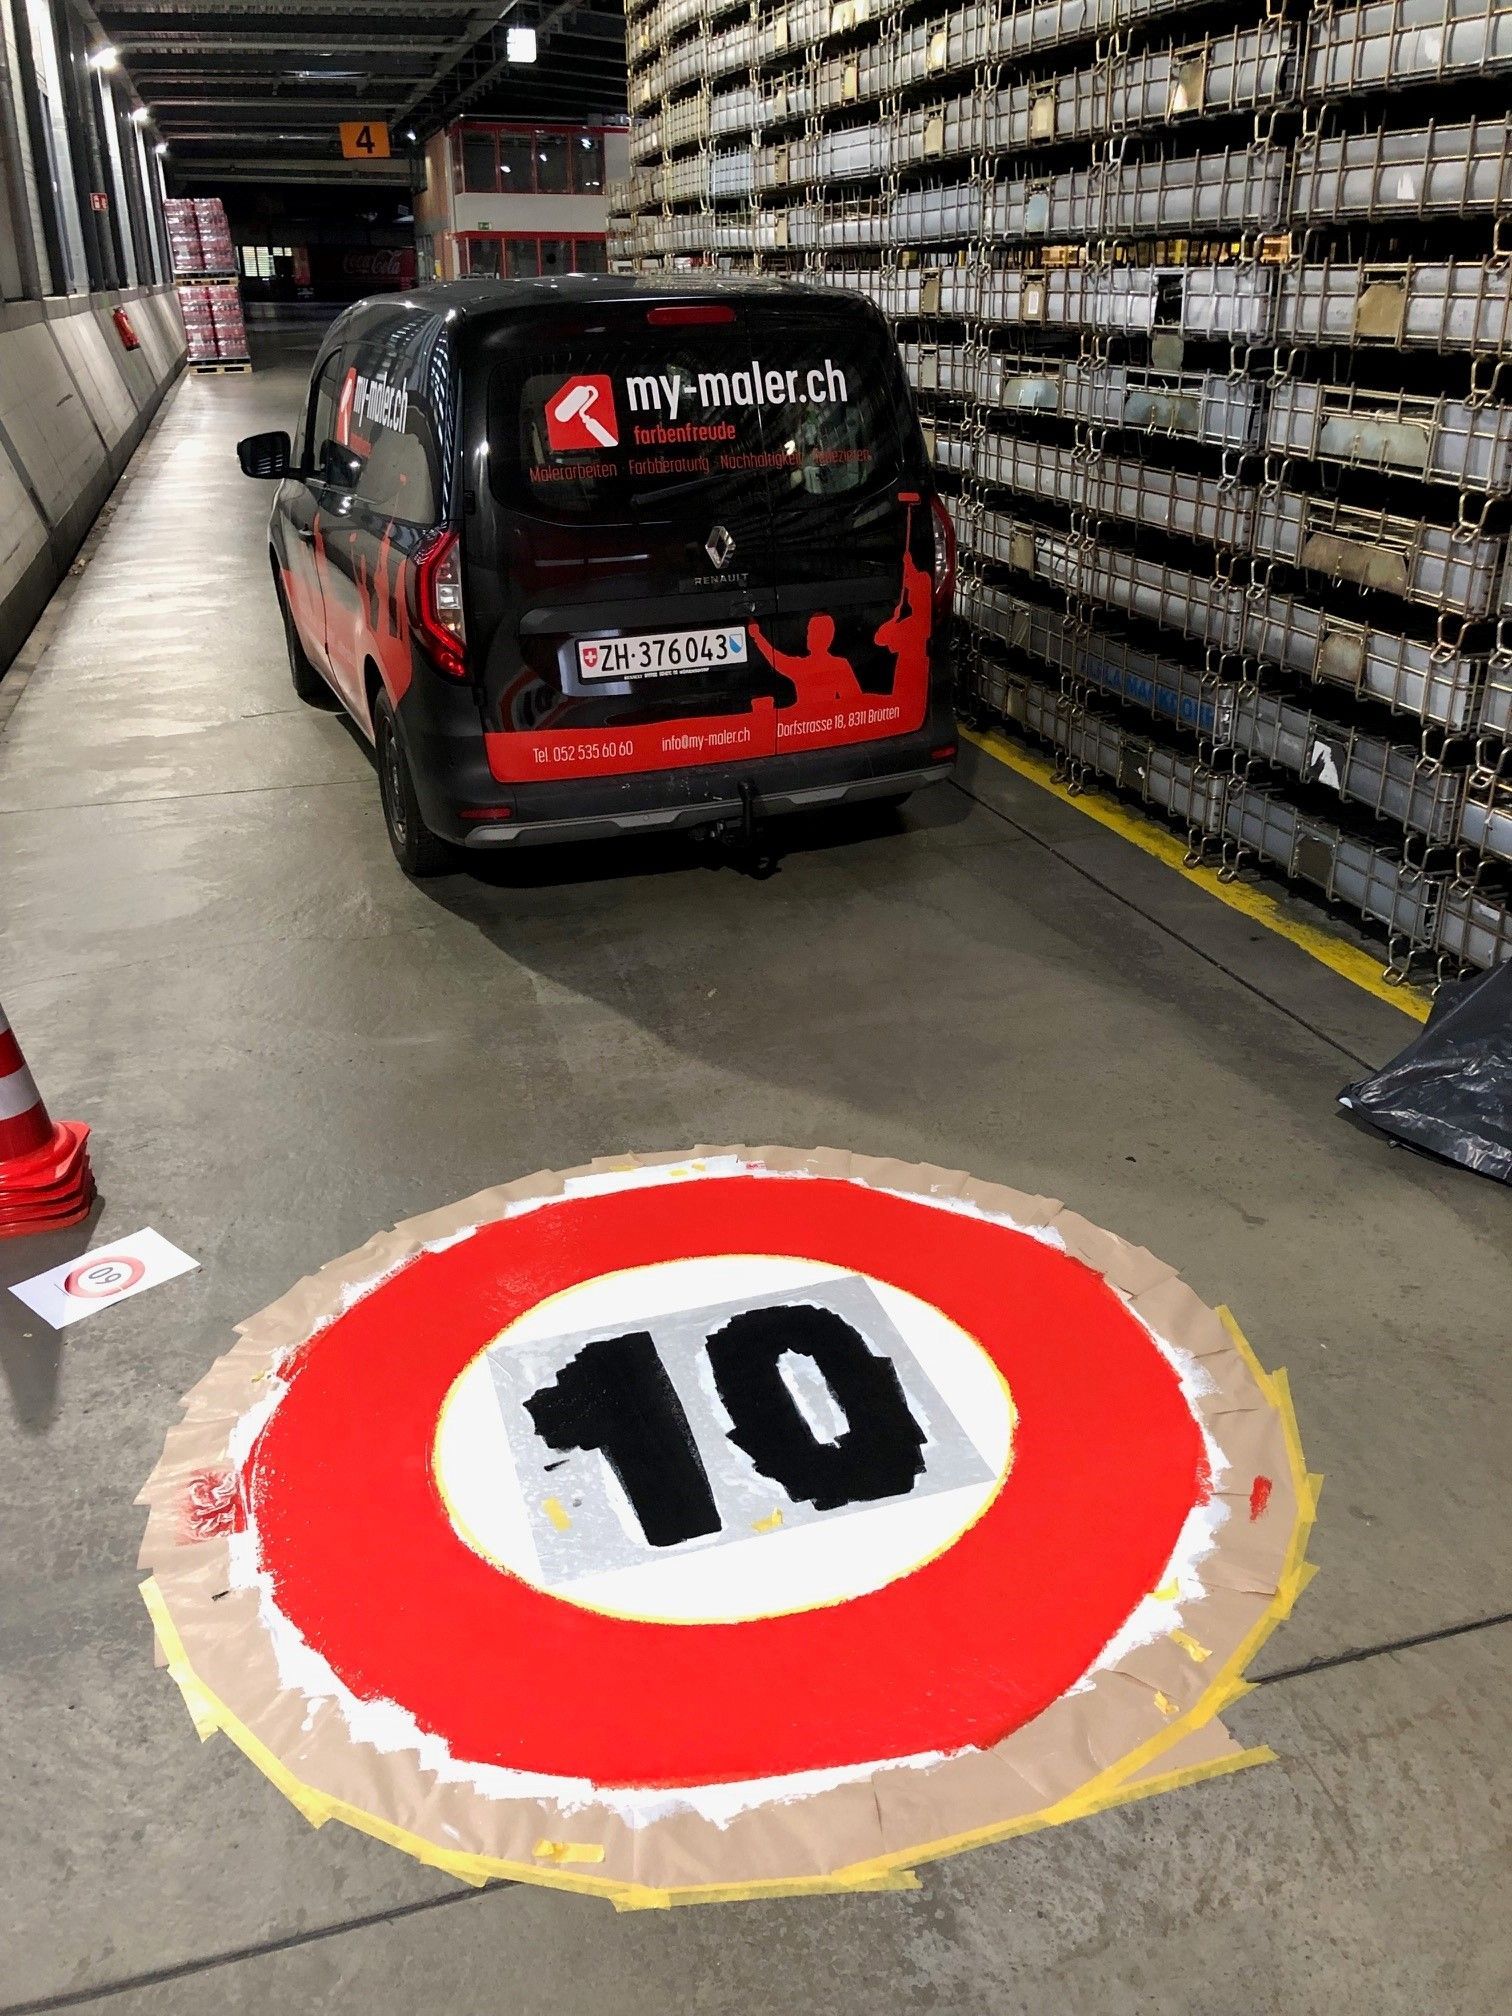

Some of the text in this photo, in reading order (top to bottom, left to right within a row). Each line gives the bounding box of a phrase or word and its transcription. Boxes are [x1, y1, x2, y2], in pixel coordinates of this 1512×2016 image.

[356, 126, 375, 154] 4
[353, 371, 408, 434] my-maler.ch
[626, 359, 848, 420] my-maler.ch
[634, 421, 736, 445] farbenfreude
[530, 463, 618, 483] Malerarbeiten
[629, 457, 710, 475] Farbberatung
[694, 573, 749, 585] RENAULT
[777, 720, 833, 738] Dorfstrasse
[848, 711, 867, 727] 8311
[553, 745, 575, 762] 052
[578, 743, 600, 760] 535
[602, 742, 617, 758] 60
[618, 740, 634, 756] 60
[662, 727, 751, 752] info@my-maler.ch
[523, 1304, 928, 1546] 10
